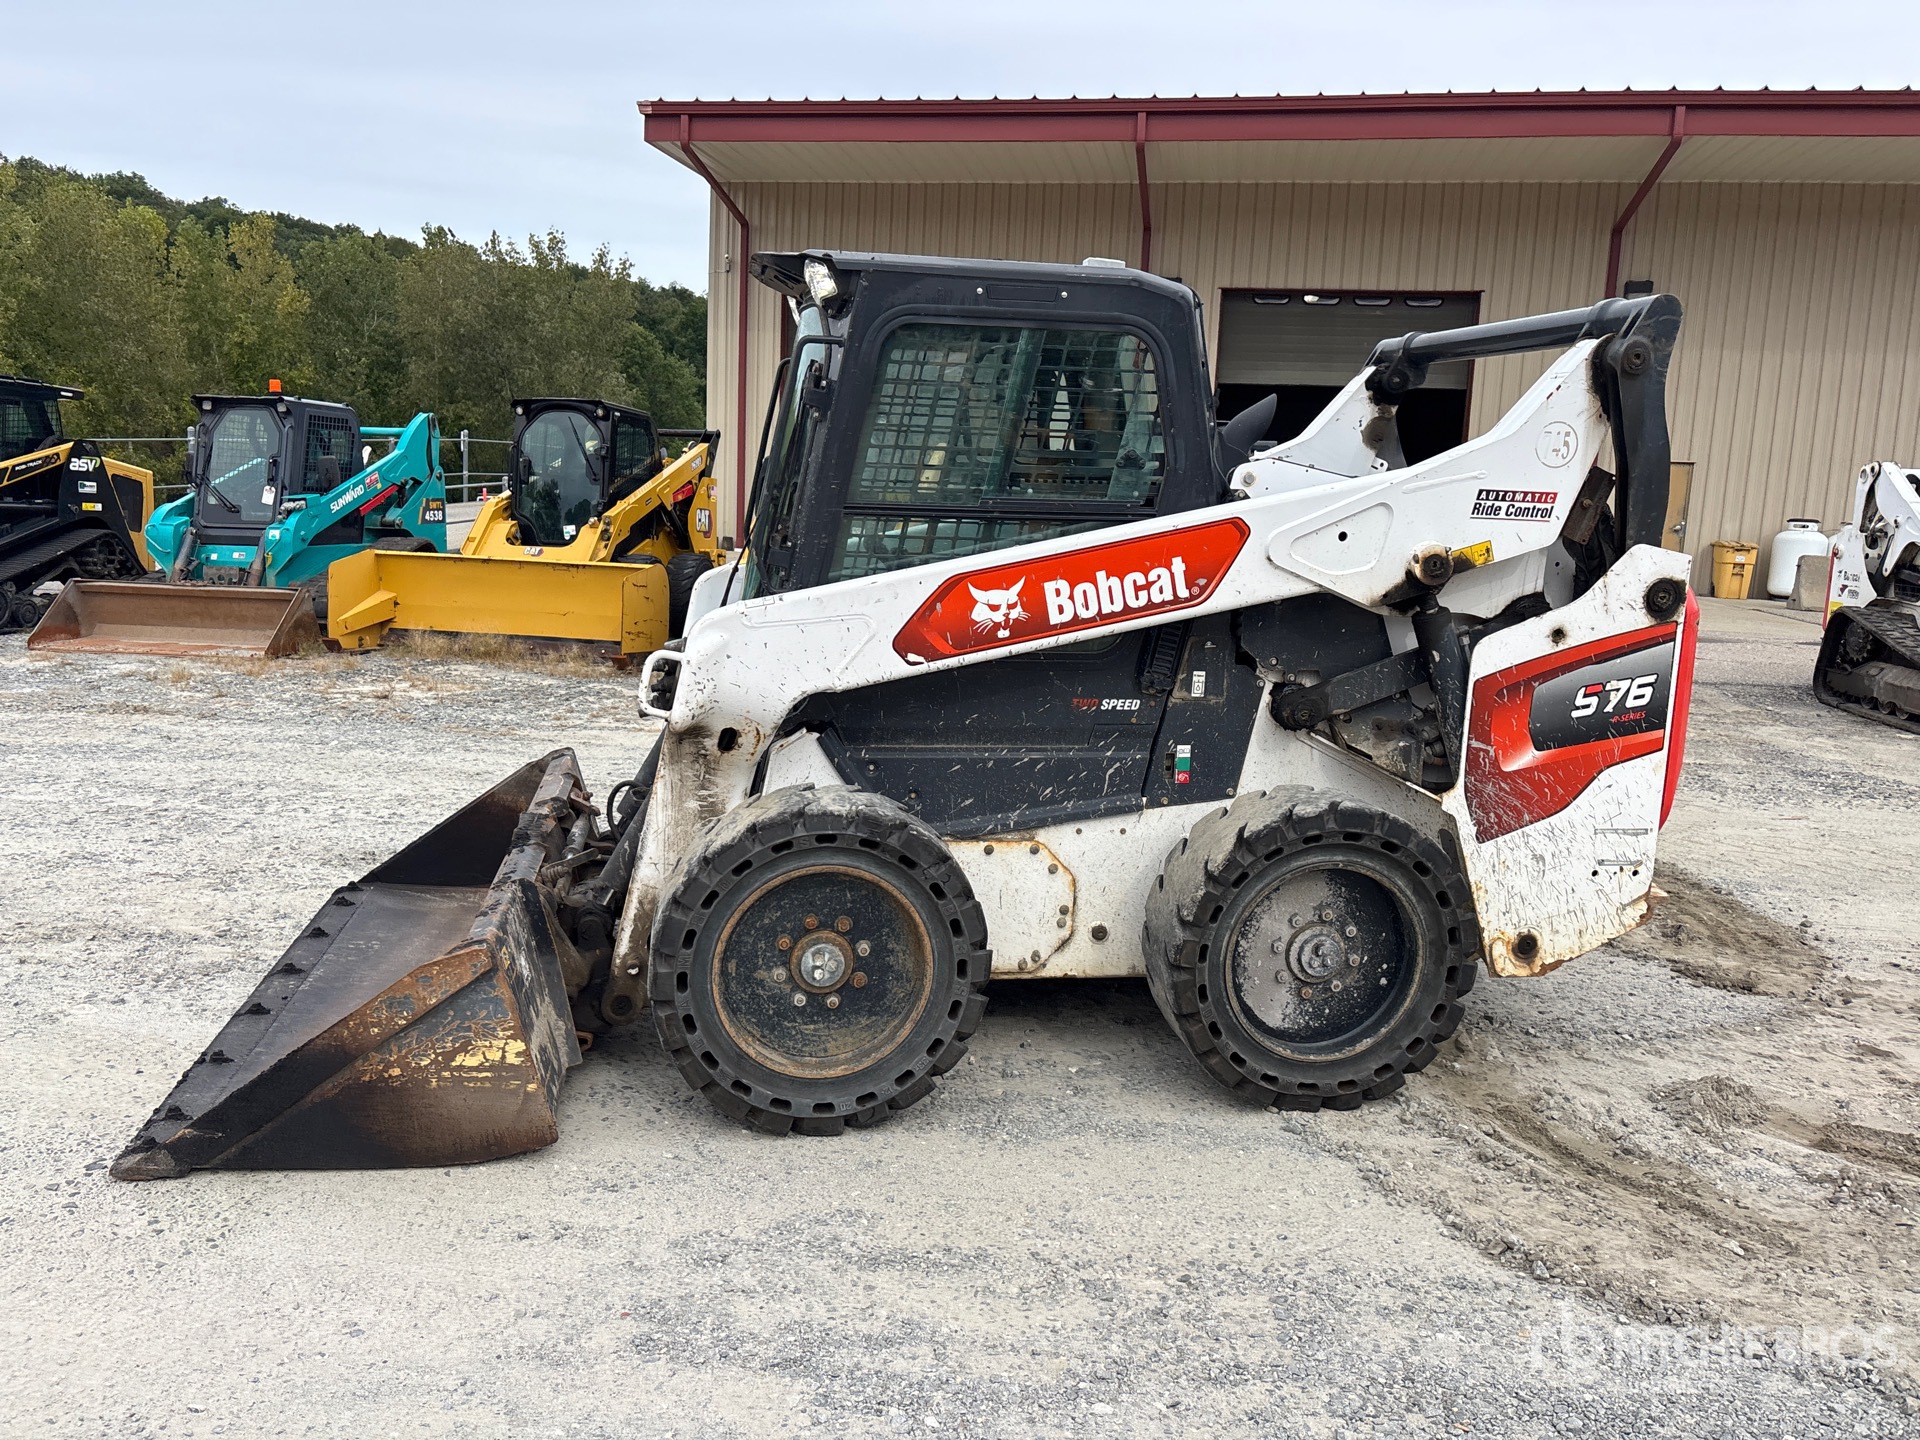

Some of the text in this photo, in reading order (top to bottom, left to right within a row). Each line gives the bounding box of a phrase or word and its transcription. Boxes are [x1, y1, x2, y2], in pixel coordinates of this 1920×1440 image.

[330, 484, 364, 514] SUNWARD
[1479, 490, 1555, 503] AUTOMATIC
[425, 510, 443, 521] 4538
[1471, 502, 1555, 519] Ride Control
[696, 508, 710, 532] CAT
[524, 547, 540, 555] CAT
[1043, 555, 1190, 626] Bobcat
[1101, 698, 1141, 710] SPEED
[1570, 674, 1658, 718] S76
